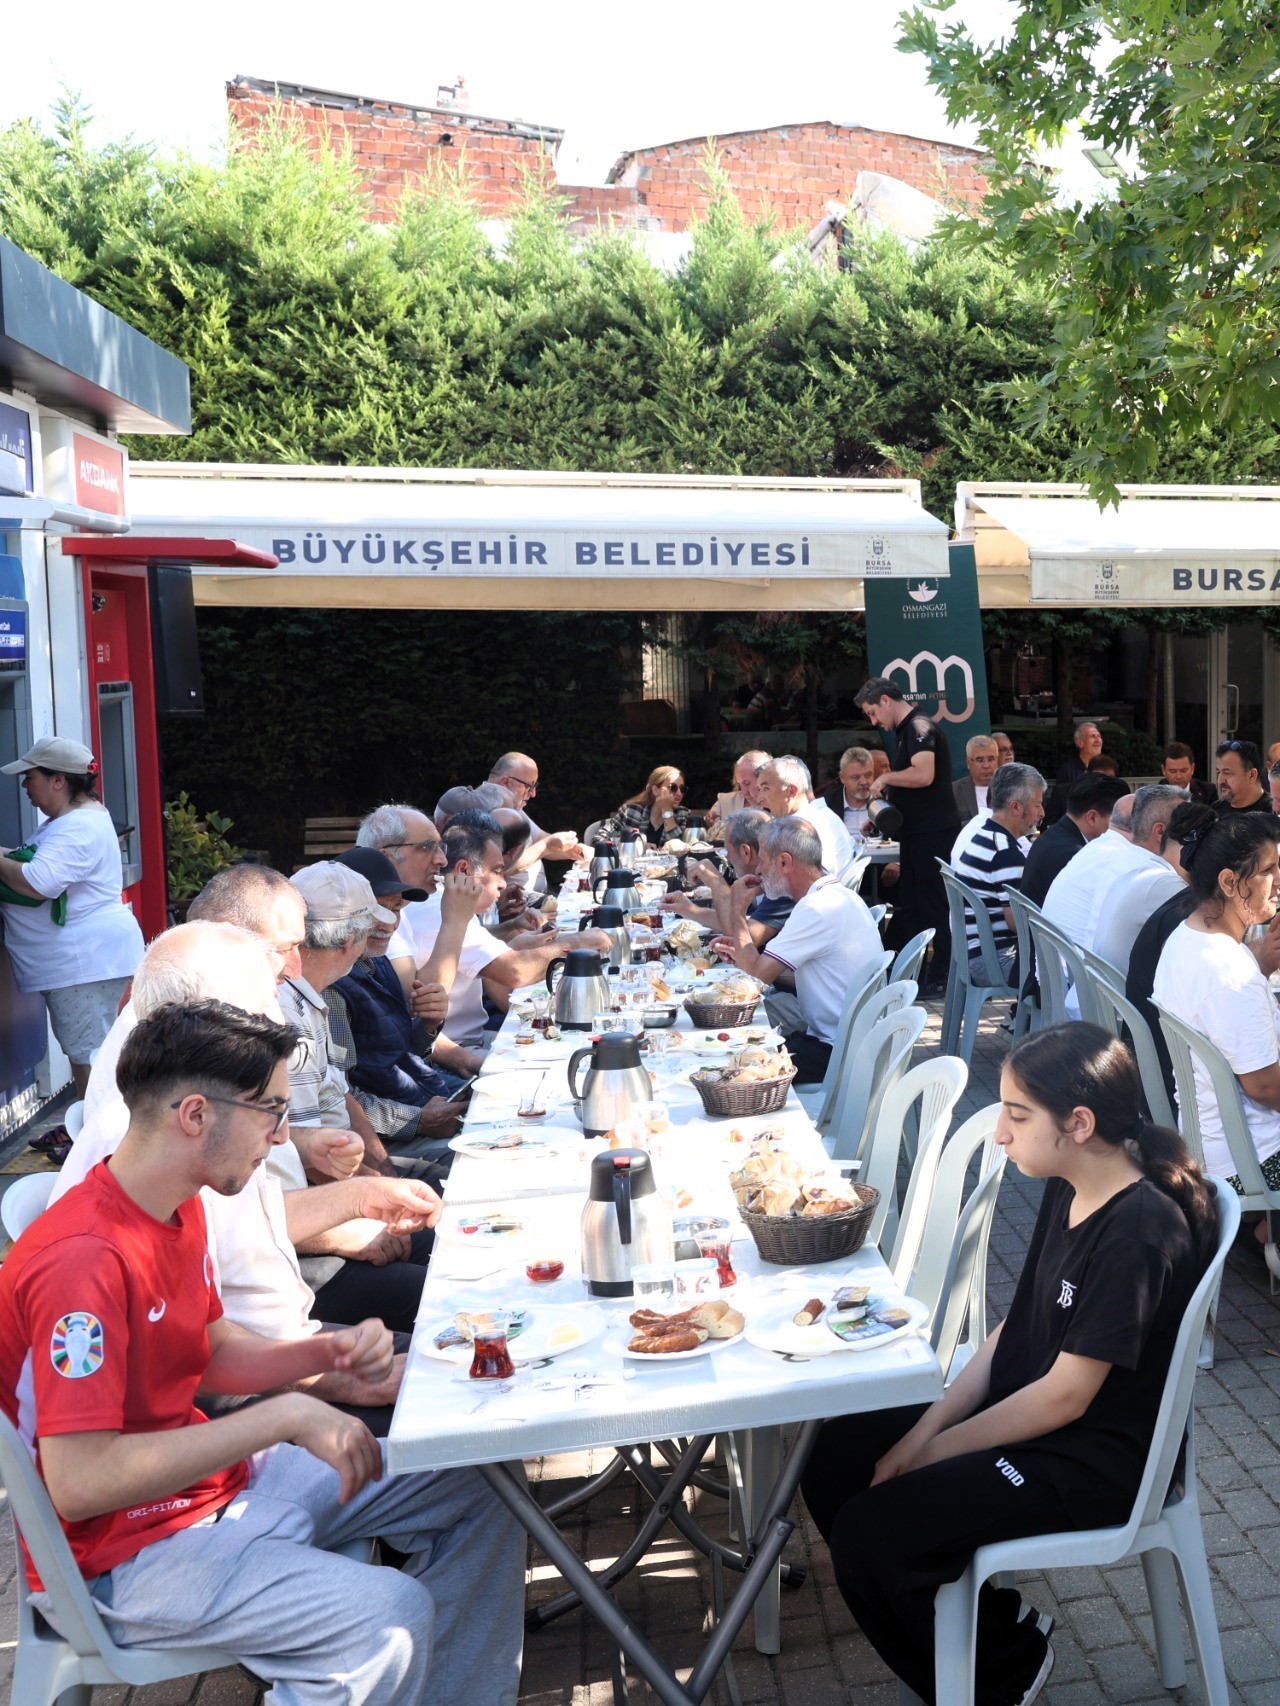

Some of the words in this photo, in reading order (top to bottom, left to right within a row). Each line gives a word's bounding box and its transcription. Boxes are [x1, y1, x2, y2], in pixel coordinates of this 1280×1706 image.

[80, 460, 119, 495] AKBANK
[272, 532, 548, 571] BÜYÜKŞEHİR
[575, 536, 810, 566] BELEDİYESİ
[902, 603, 947, 613] OSMANGAZİ
[903, 611, 948, 620] BELEDİYESİ
[995, 1457, 1025, 1488] VOID
